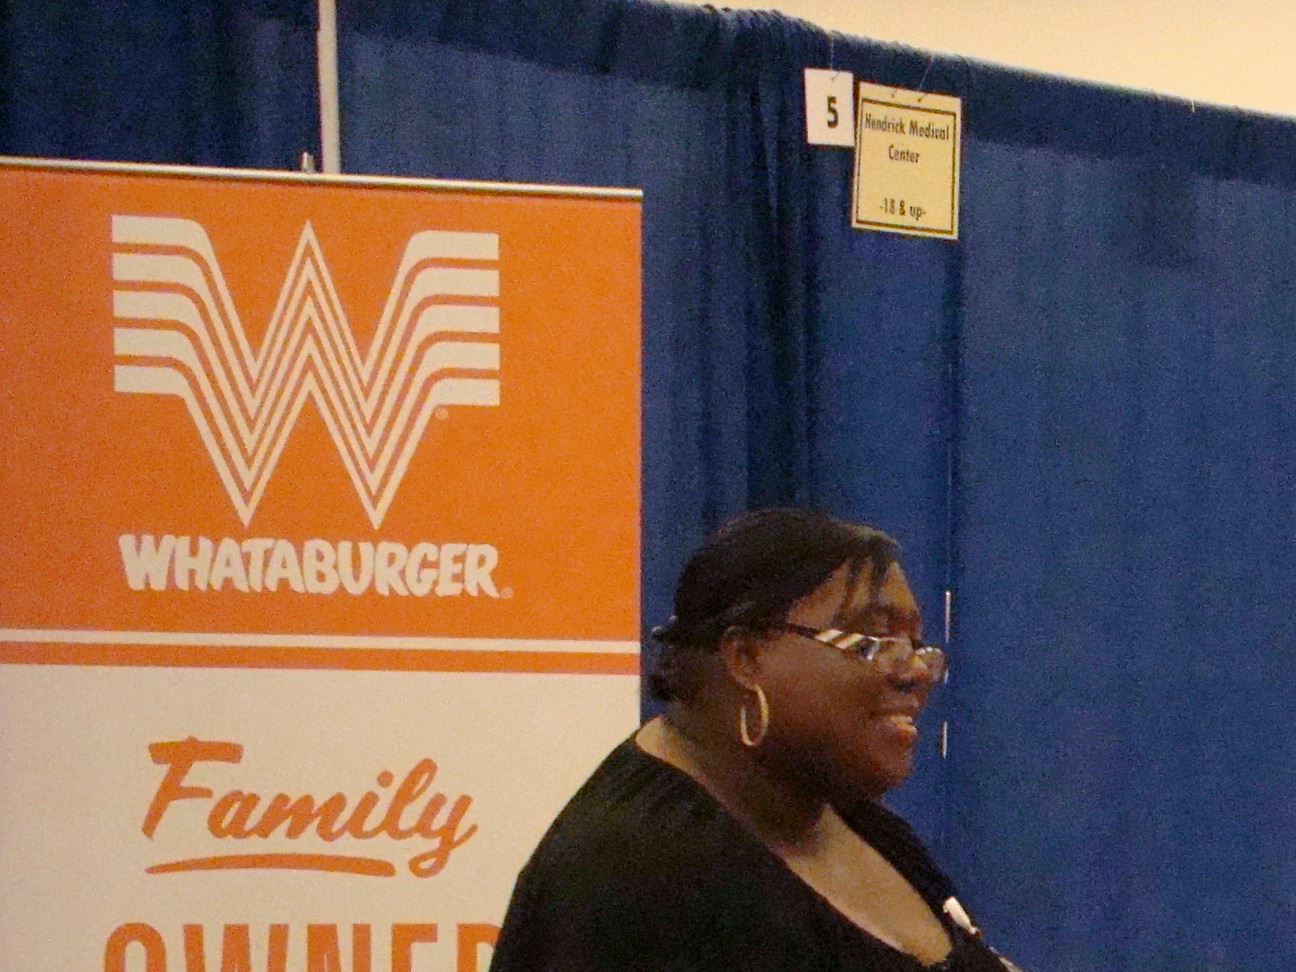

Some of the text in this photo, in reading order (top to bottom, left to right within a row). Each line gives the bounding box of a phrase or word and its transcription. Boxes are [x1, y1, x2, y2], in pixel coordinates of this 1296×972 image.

[826, 96, 839, 128] 5
[864, 113, 950, 140] Hendrick Medical
[888, 144, 921, 164] Center
[899, 201, 905, 215] &
[118, 532, 501, 599] WHATABURGER
[141, 736, 478, 877] Family
